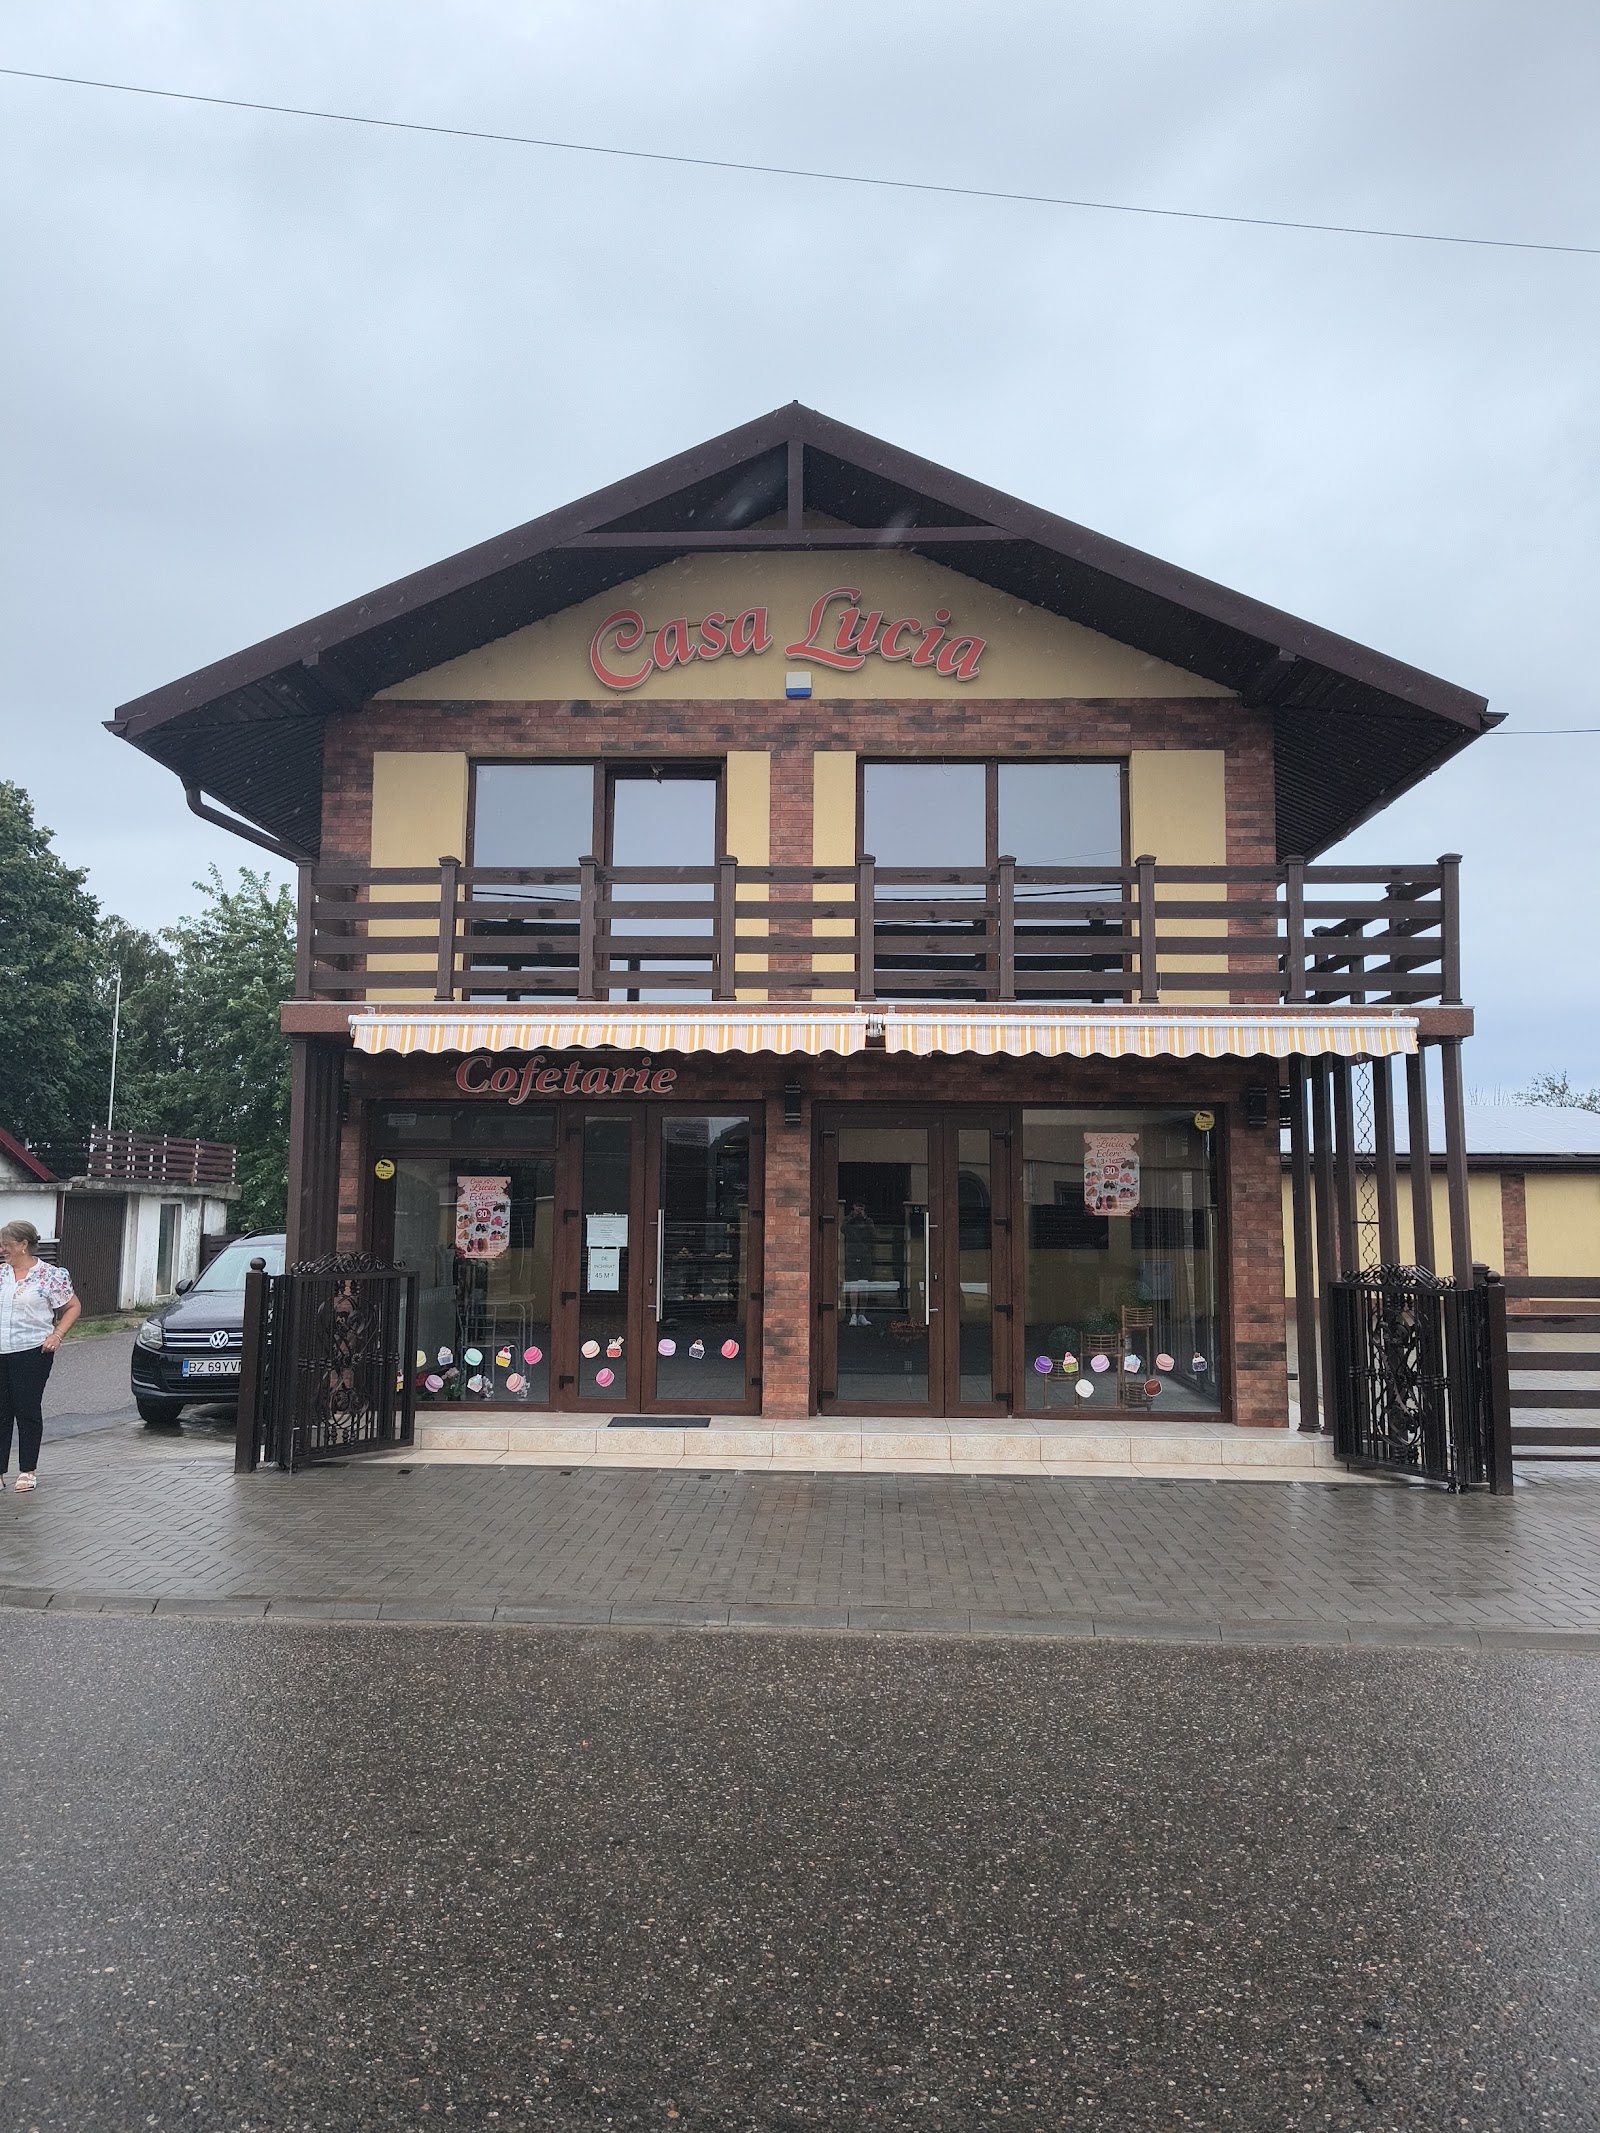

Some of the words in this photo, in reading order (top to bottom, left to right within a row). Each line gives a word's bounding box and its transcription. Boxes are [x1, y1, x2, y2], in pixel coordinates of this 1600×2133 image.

[589, 606, 774, 691] Casa
[785, 586, 988, 682] Lucia
[455, 1055, 678, 1106] Cofetarie
[1105, 1166, 1116, 1175] 30
[469, 1183, 498, 1193] Lucia
[477, 1209, 488, 1218] 30
[189, 1361, 205, 1373] BZ
[208, 1361, 222, 1372] 69
